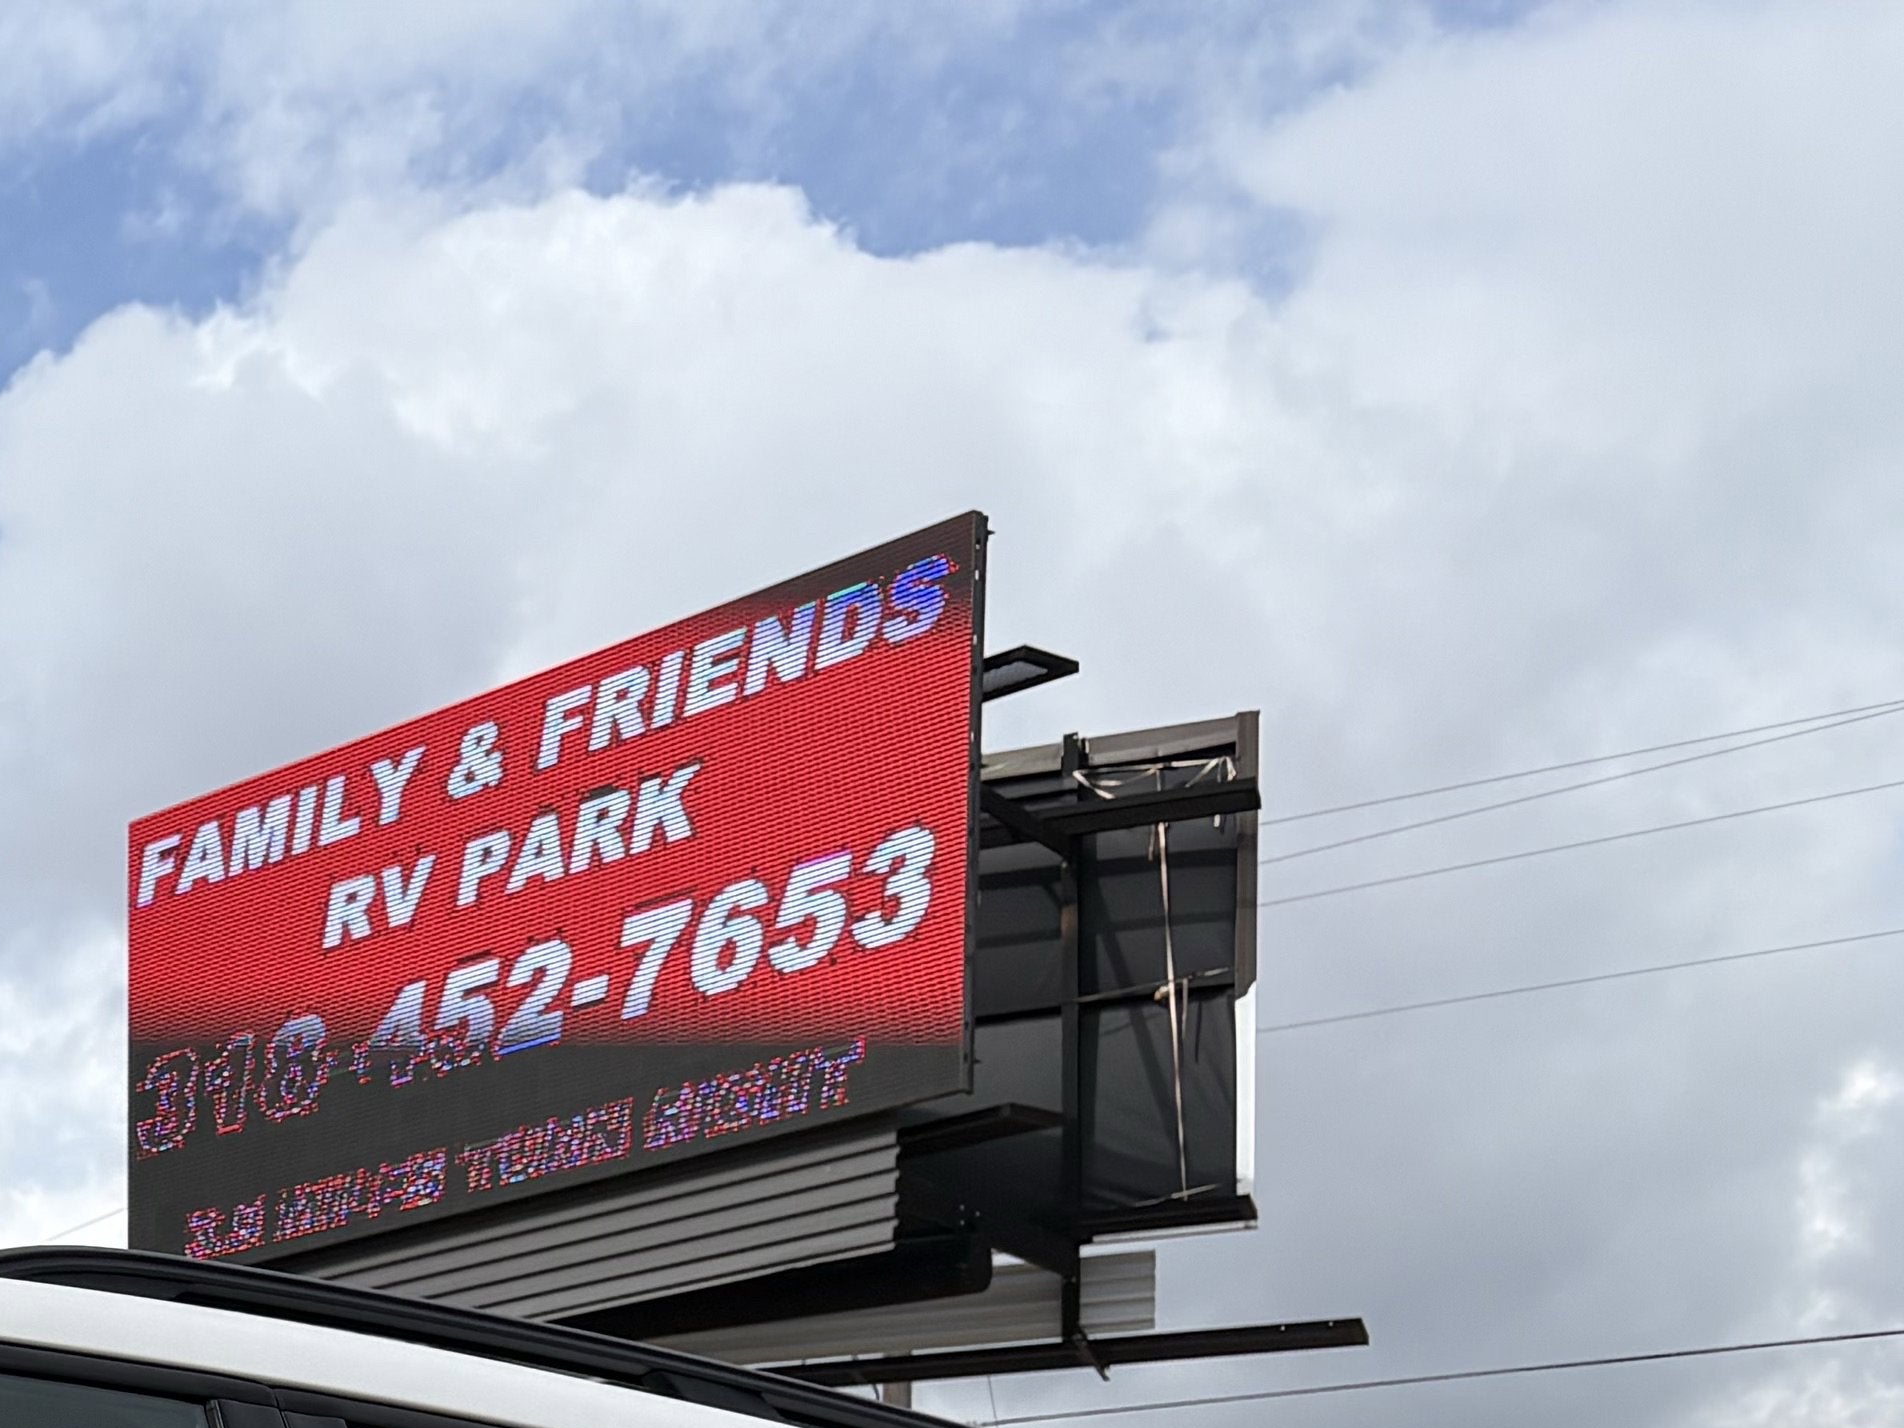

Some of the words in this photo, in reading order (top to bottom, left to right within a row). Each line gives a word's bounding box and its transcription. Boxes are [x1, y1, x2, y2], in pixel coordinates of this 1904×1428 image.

[135, 746, 425, 908] FAMILY
[445, 720, 504, 800] &
[534, 554, 956, 772] FRIENDS
[321, 854, 436, 950] RV
[453, 762, 701, 908] PARK
[135, 824, 937, 1158] 318-452-7653
